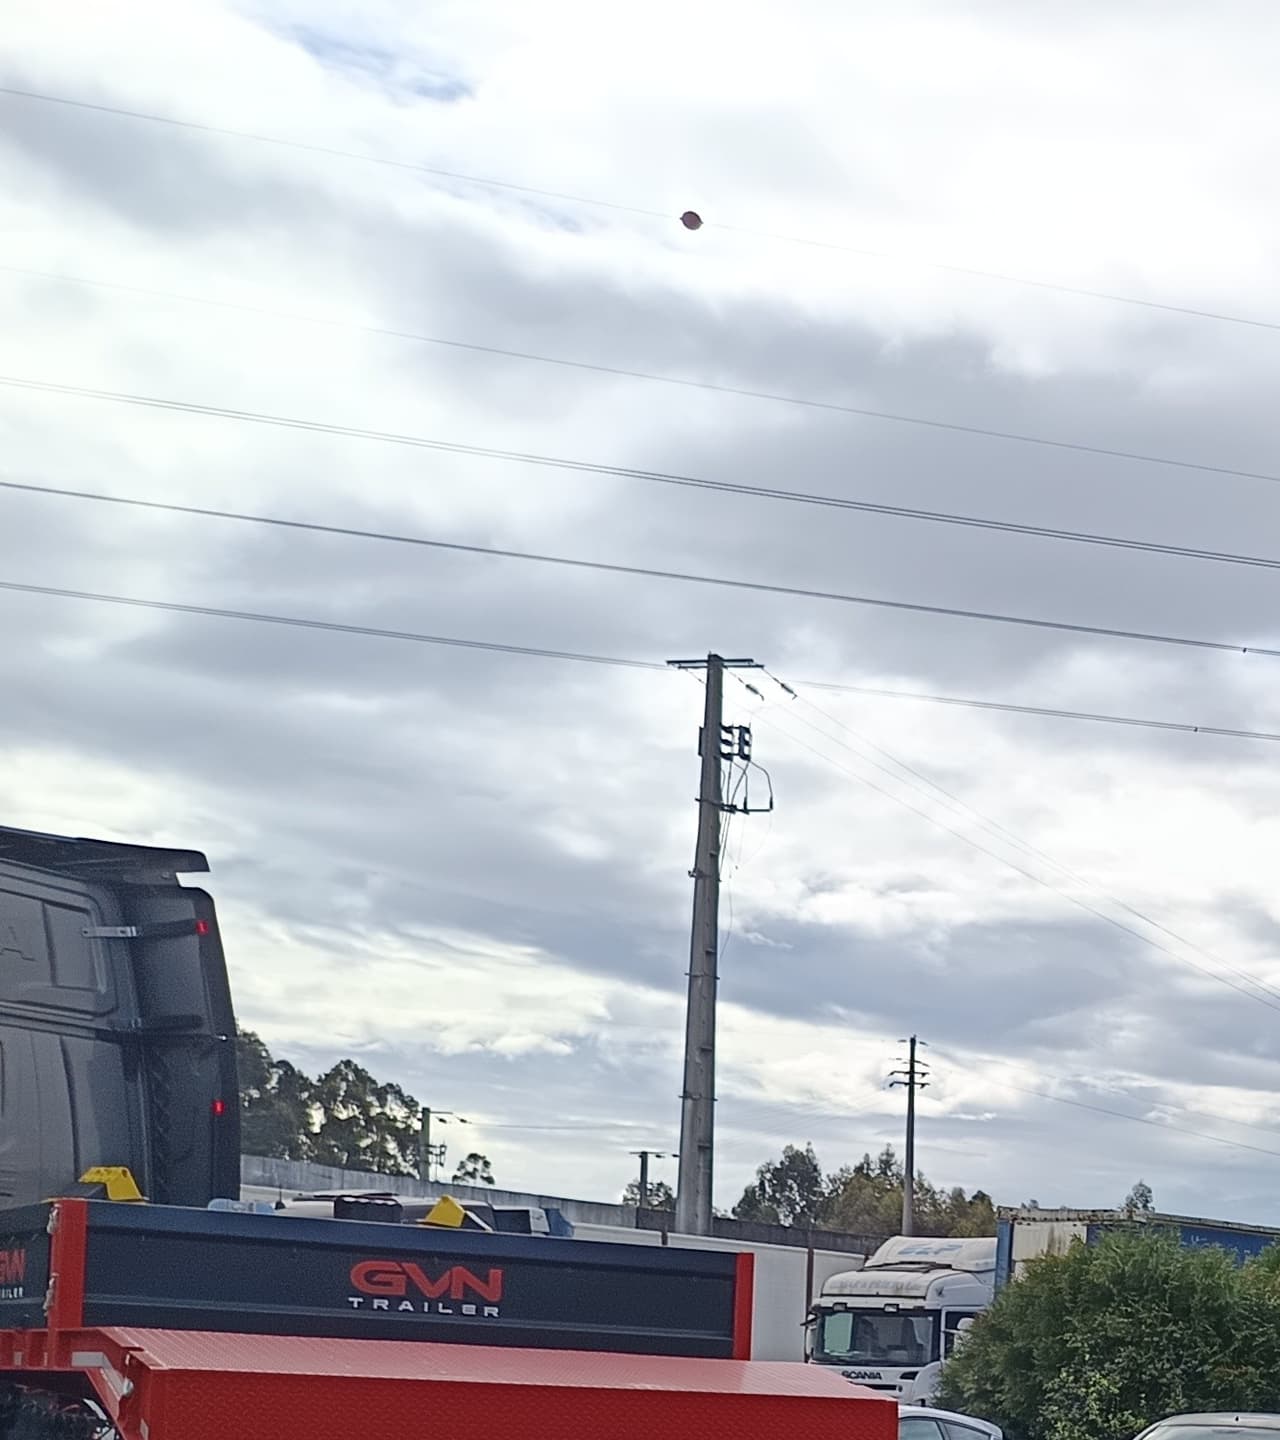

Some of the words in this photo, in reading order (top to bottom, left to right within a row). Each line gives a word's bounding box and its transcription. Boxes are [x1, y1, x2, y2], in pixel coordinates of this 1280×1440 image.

[350, 1260, 504, 1302] GVN
[348, 1297, 500, 1318] TRAILER
[841, 1369, 882, 1381] SCANIA
